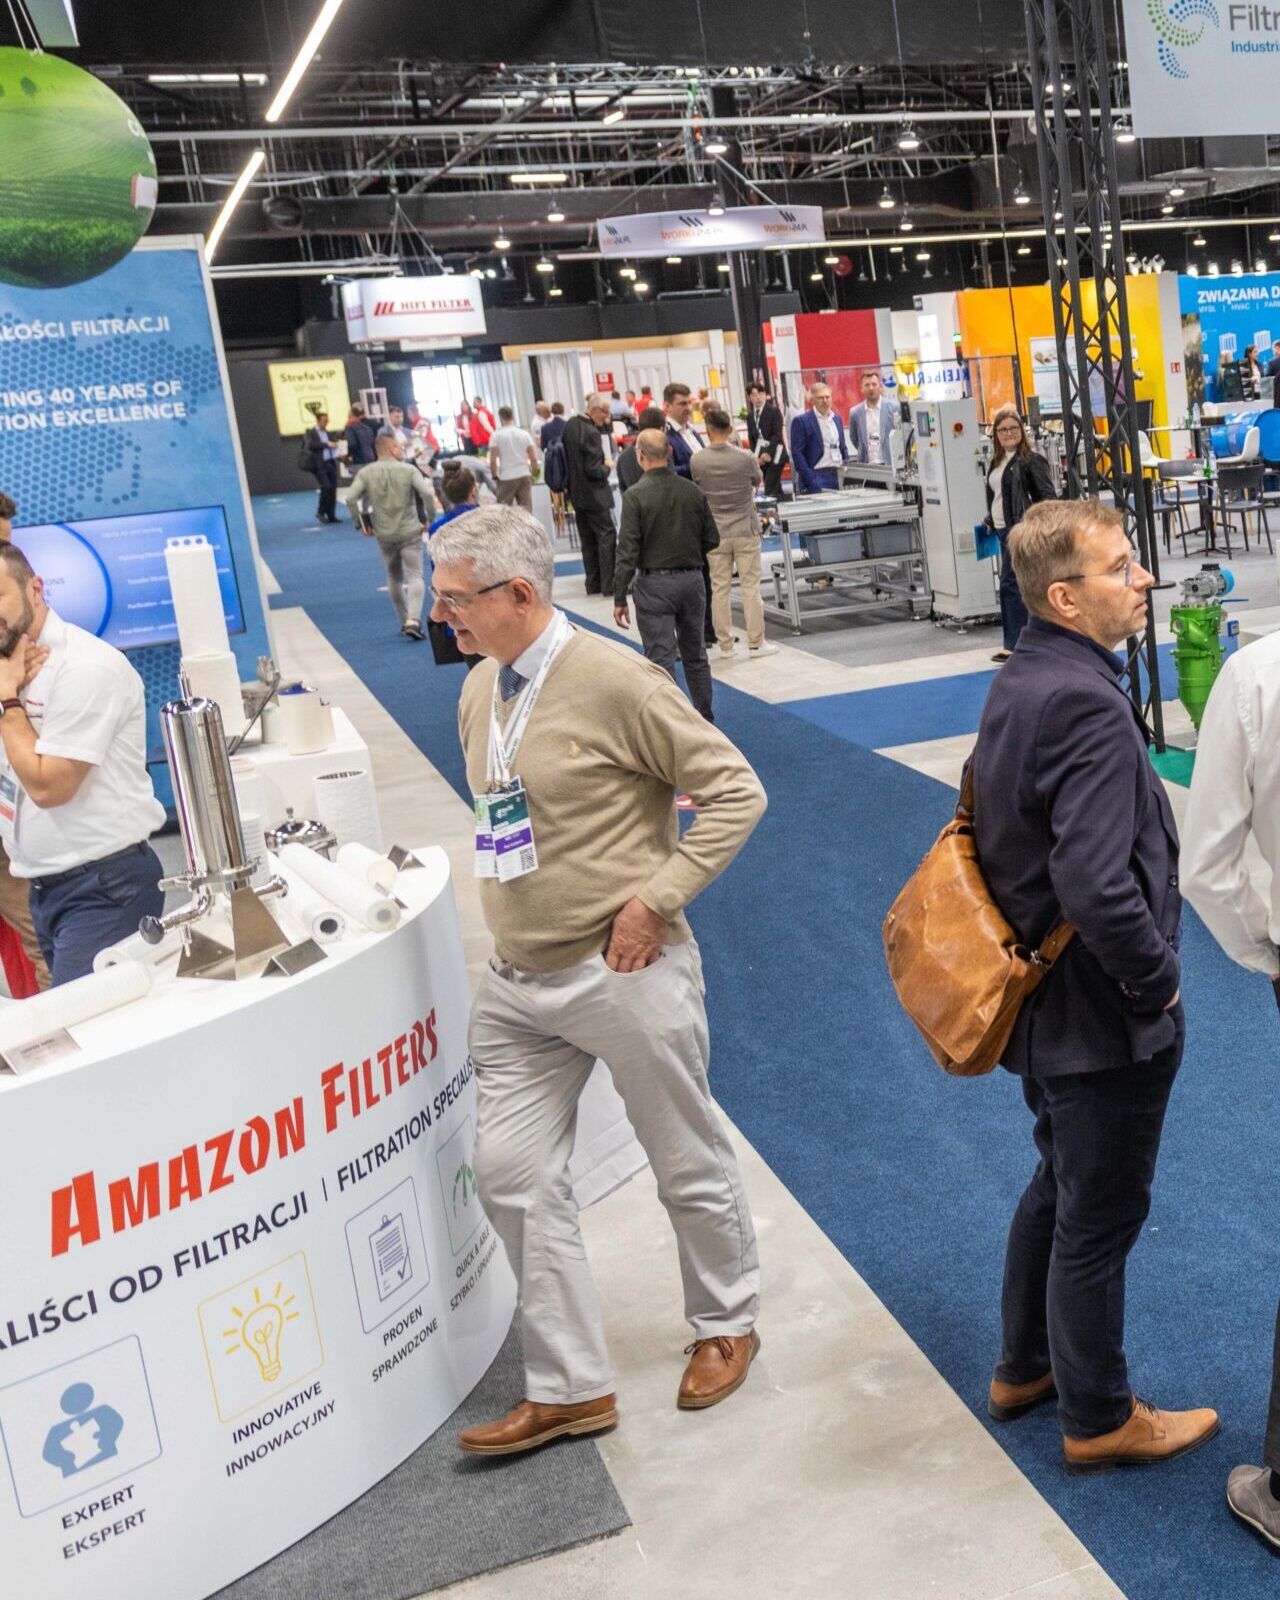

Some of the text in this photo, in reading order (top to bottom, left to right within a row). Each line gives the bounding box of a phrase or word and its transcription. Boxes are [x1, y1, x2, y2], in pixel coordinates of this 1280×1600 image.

[71, 315, 171, 337] FILTRACJI
[400, 298, 471, 311] HIFI FILTER
[49, 387, 75, 405] 40
[79, 382, 147, 402] YEARS
[152, 380, 183, 397] OF
[279, 370, 336, 384] Strefa VIP
[52, 401, 187, 428] EXCELLENCE
[51, 1007, 439, 1258] AMAZON FILTERS
[336, 1105, 432, 1193] FILTRATION
[0, 1190, 309, 1351] LIŚCI OD FILTRACJI
[455, 1249, 475, 1279] QUICK
[450, 1275, 475, 1312] SZYBKO
[382, 1304, 423, 1347] PROVEN
[371, 1317, 439, 1383] SPRAWDZONE
[232, 1381, 323, 1444] INNOVATIVE
[225, 1399, 336, 1477] INNOWACYJNY
[61, 1484, 135, 1530] EXPERT
[62, 1508, 147, 1560] EKSPERT
